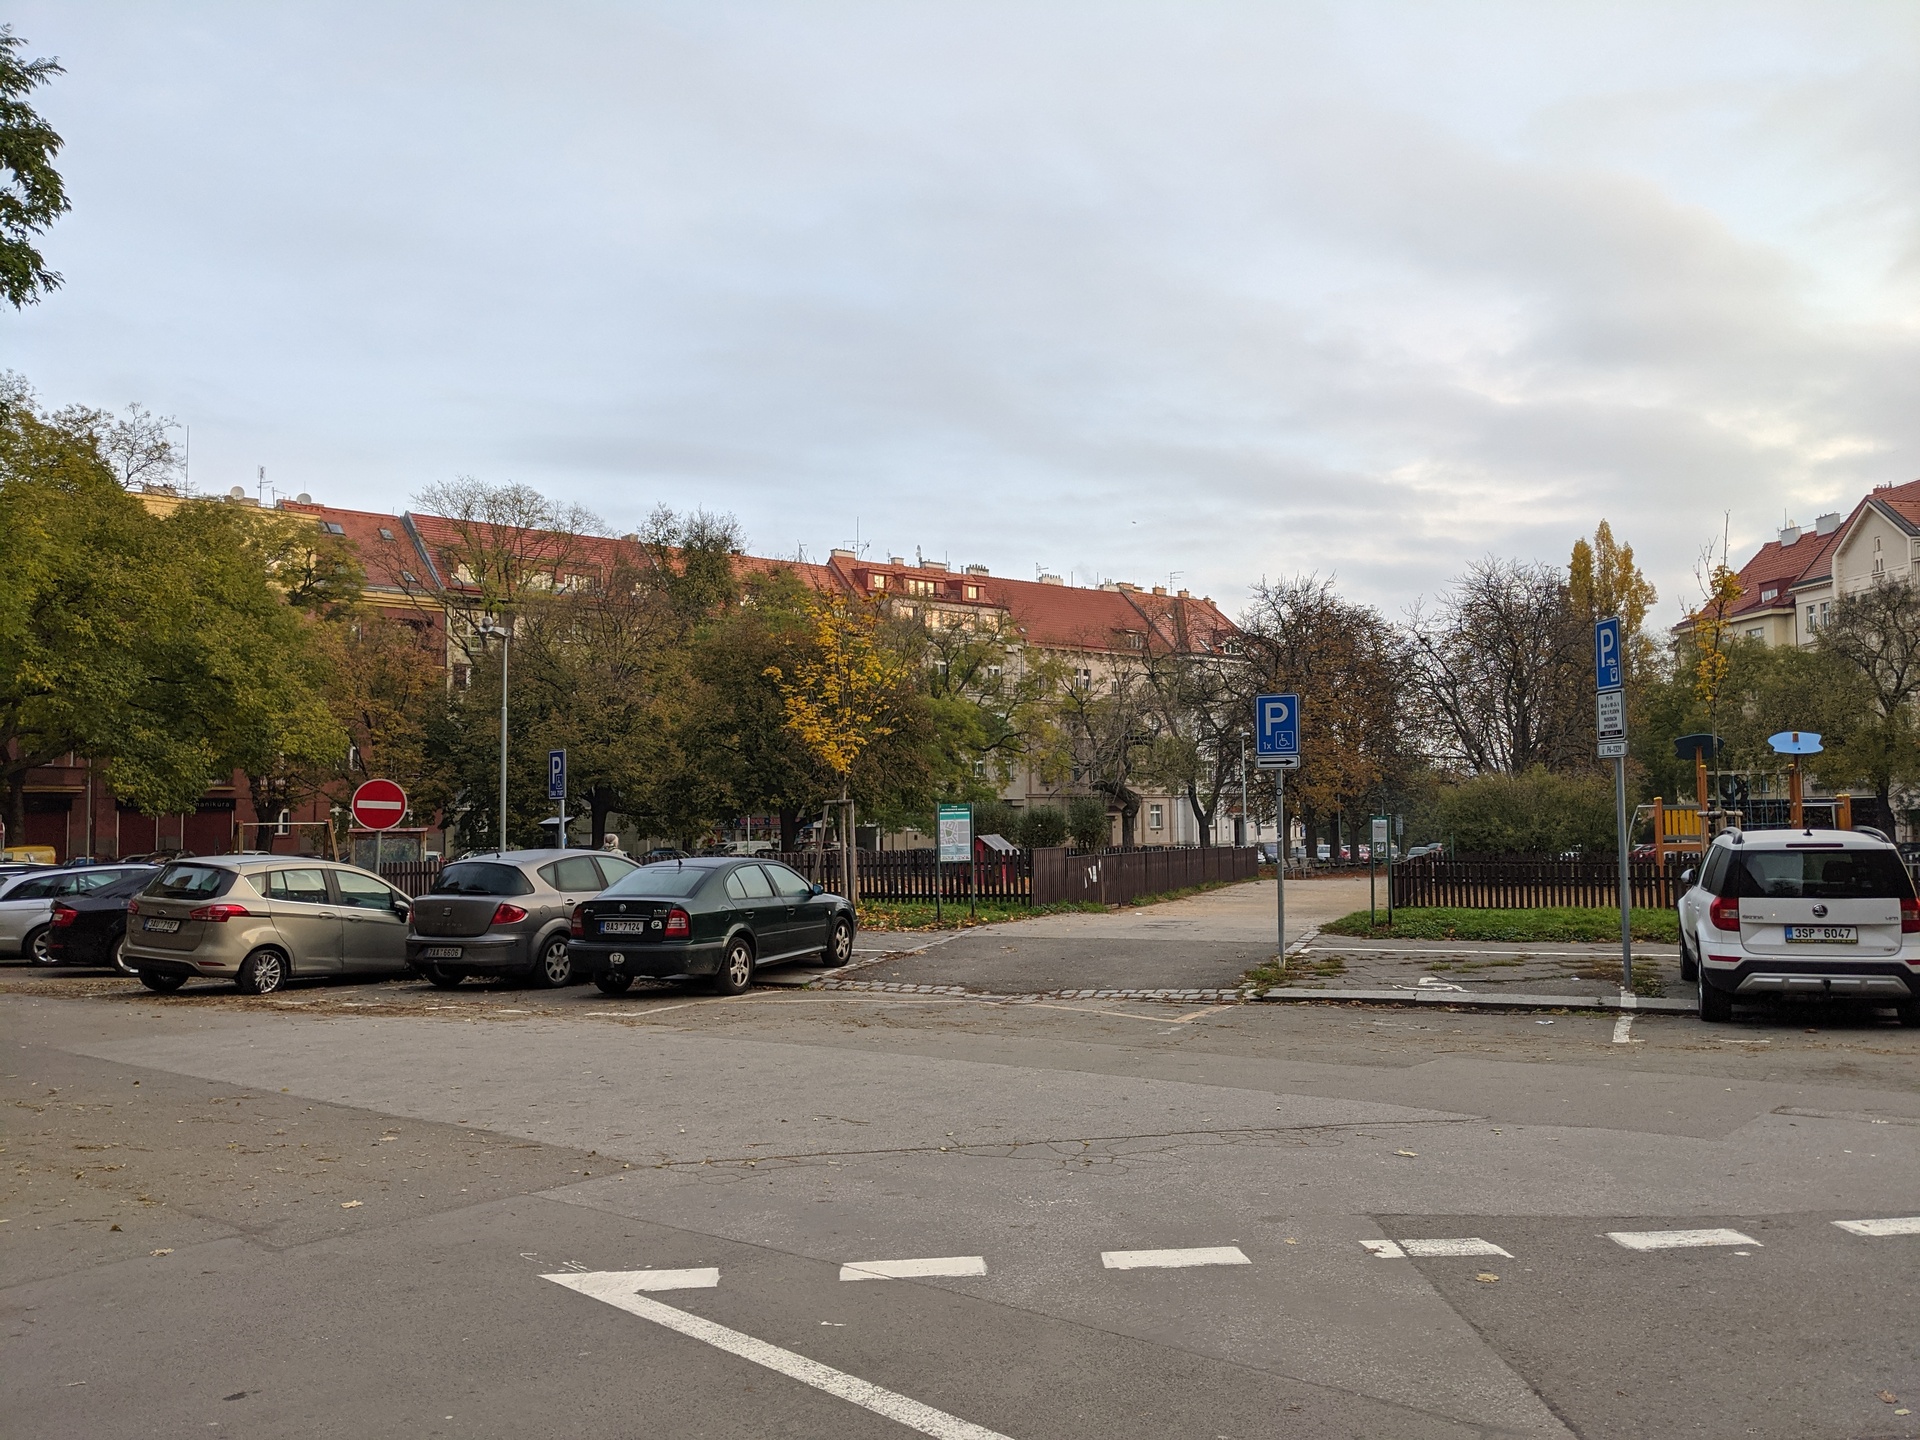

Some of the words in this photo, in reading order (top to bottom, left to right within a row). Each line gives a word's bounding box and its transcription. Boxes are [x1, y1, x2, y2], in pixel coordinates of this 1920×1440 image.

[1600, 628, 1614, 668] P
[1265, 702, 1289, 736] P
[1263, 741, 1272, 750] 1x
[552, 756, 562, 784] P
[605, 922, 619, 931] 8A3
[623, 921, 640, 931] 7124
[1795, 928, 1815, 939] 3SP
[1824, 928, 1851, 939] 6047
[612, 954, 622, 962] CZ
